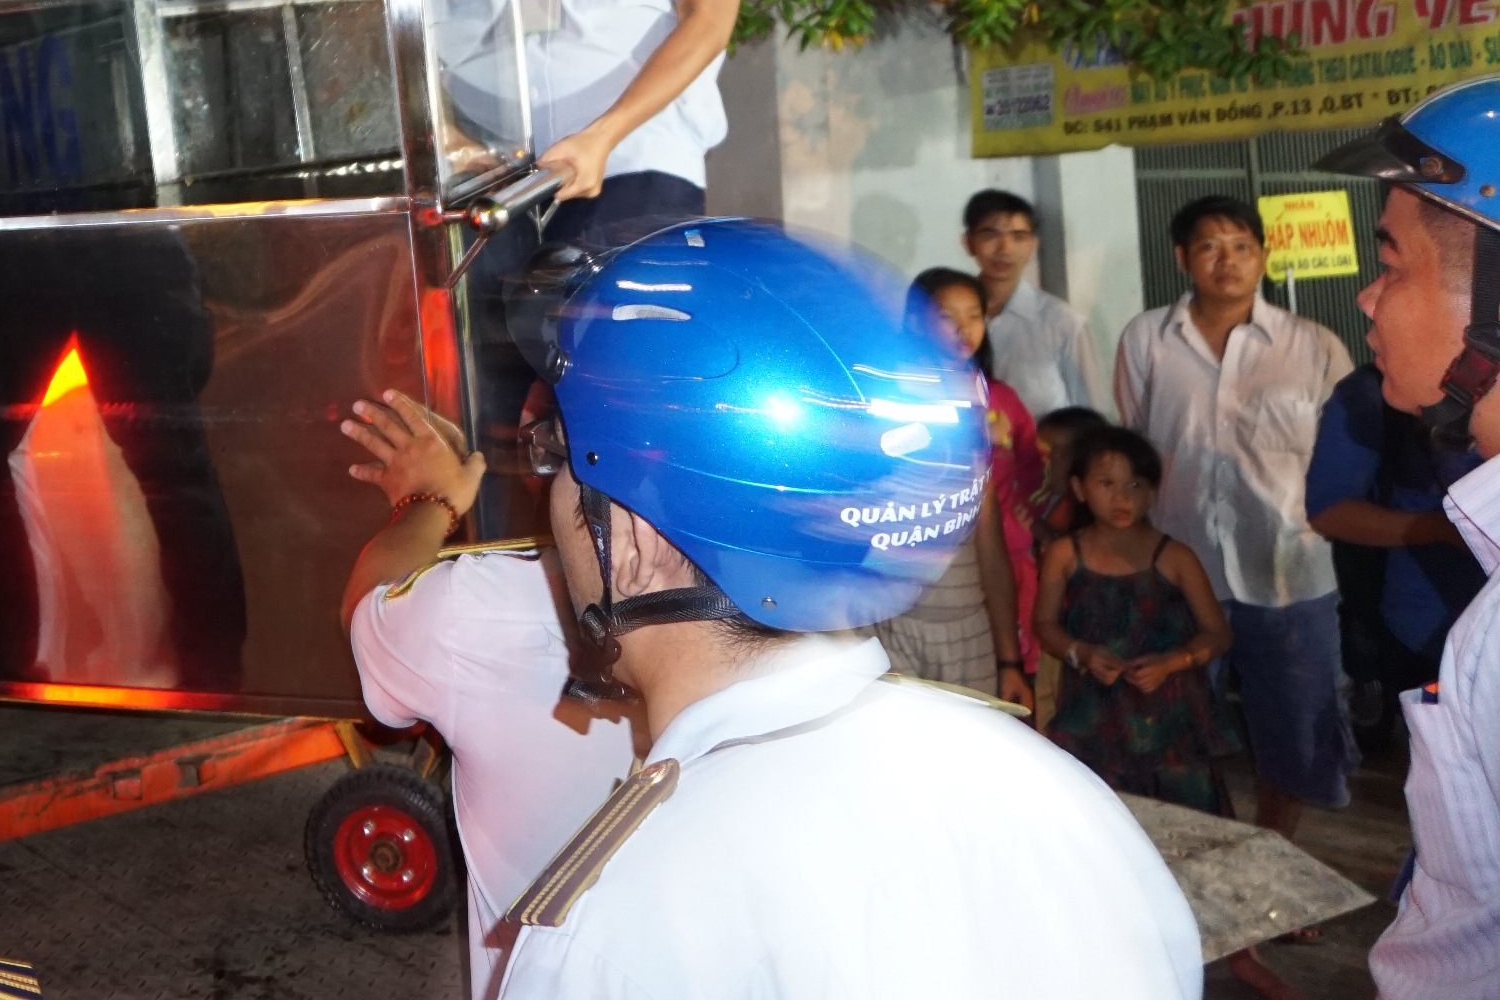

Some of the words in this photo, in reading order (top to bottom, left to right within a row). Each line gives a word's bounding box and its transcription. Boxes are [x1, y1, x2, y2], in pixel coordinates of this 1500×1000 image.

[840, 501, 916, 528] QUẢN
[921, 493, 947, 518] LÝ
[949, 474, 986, 510] TRẬT
[870, 525, 940, 551] QUẬN
